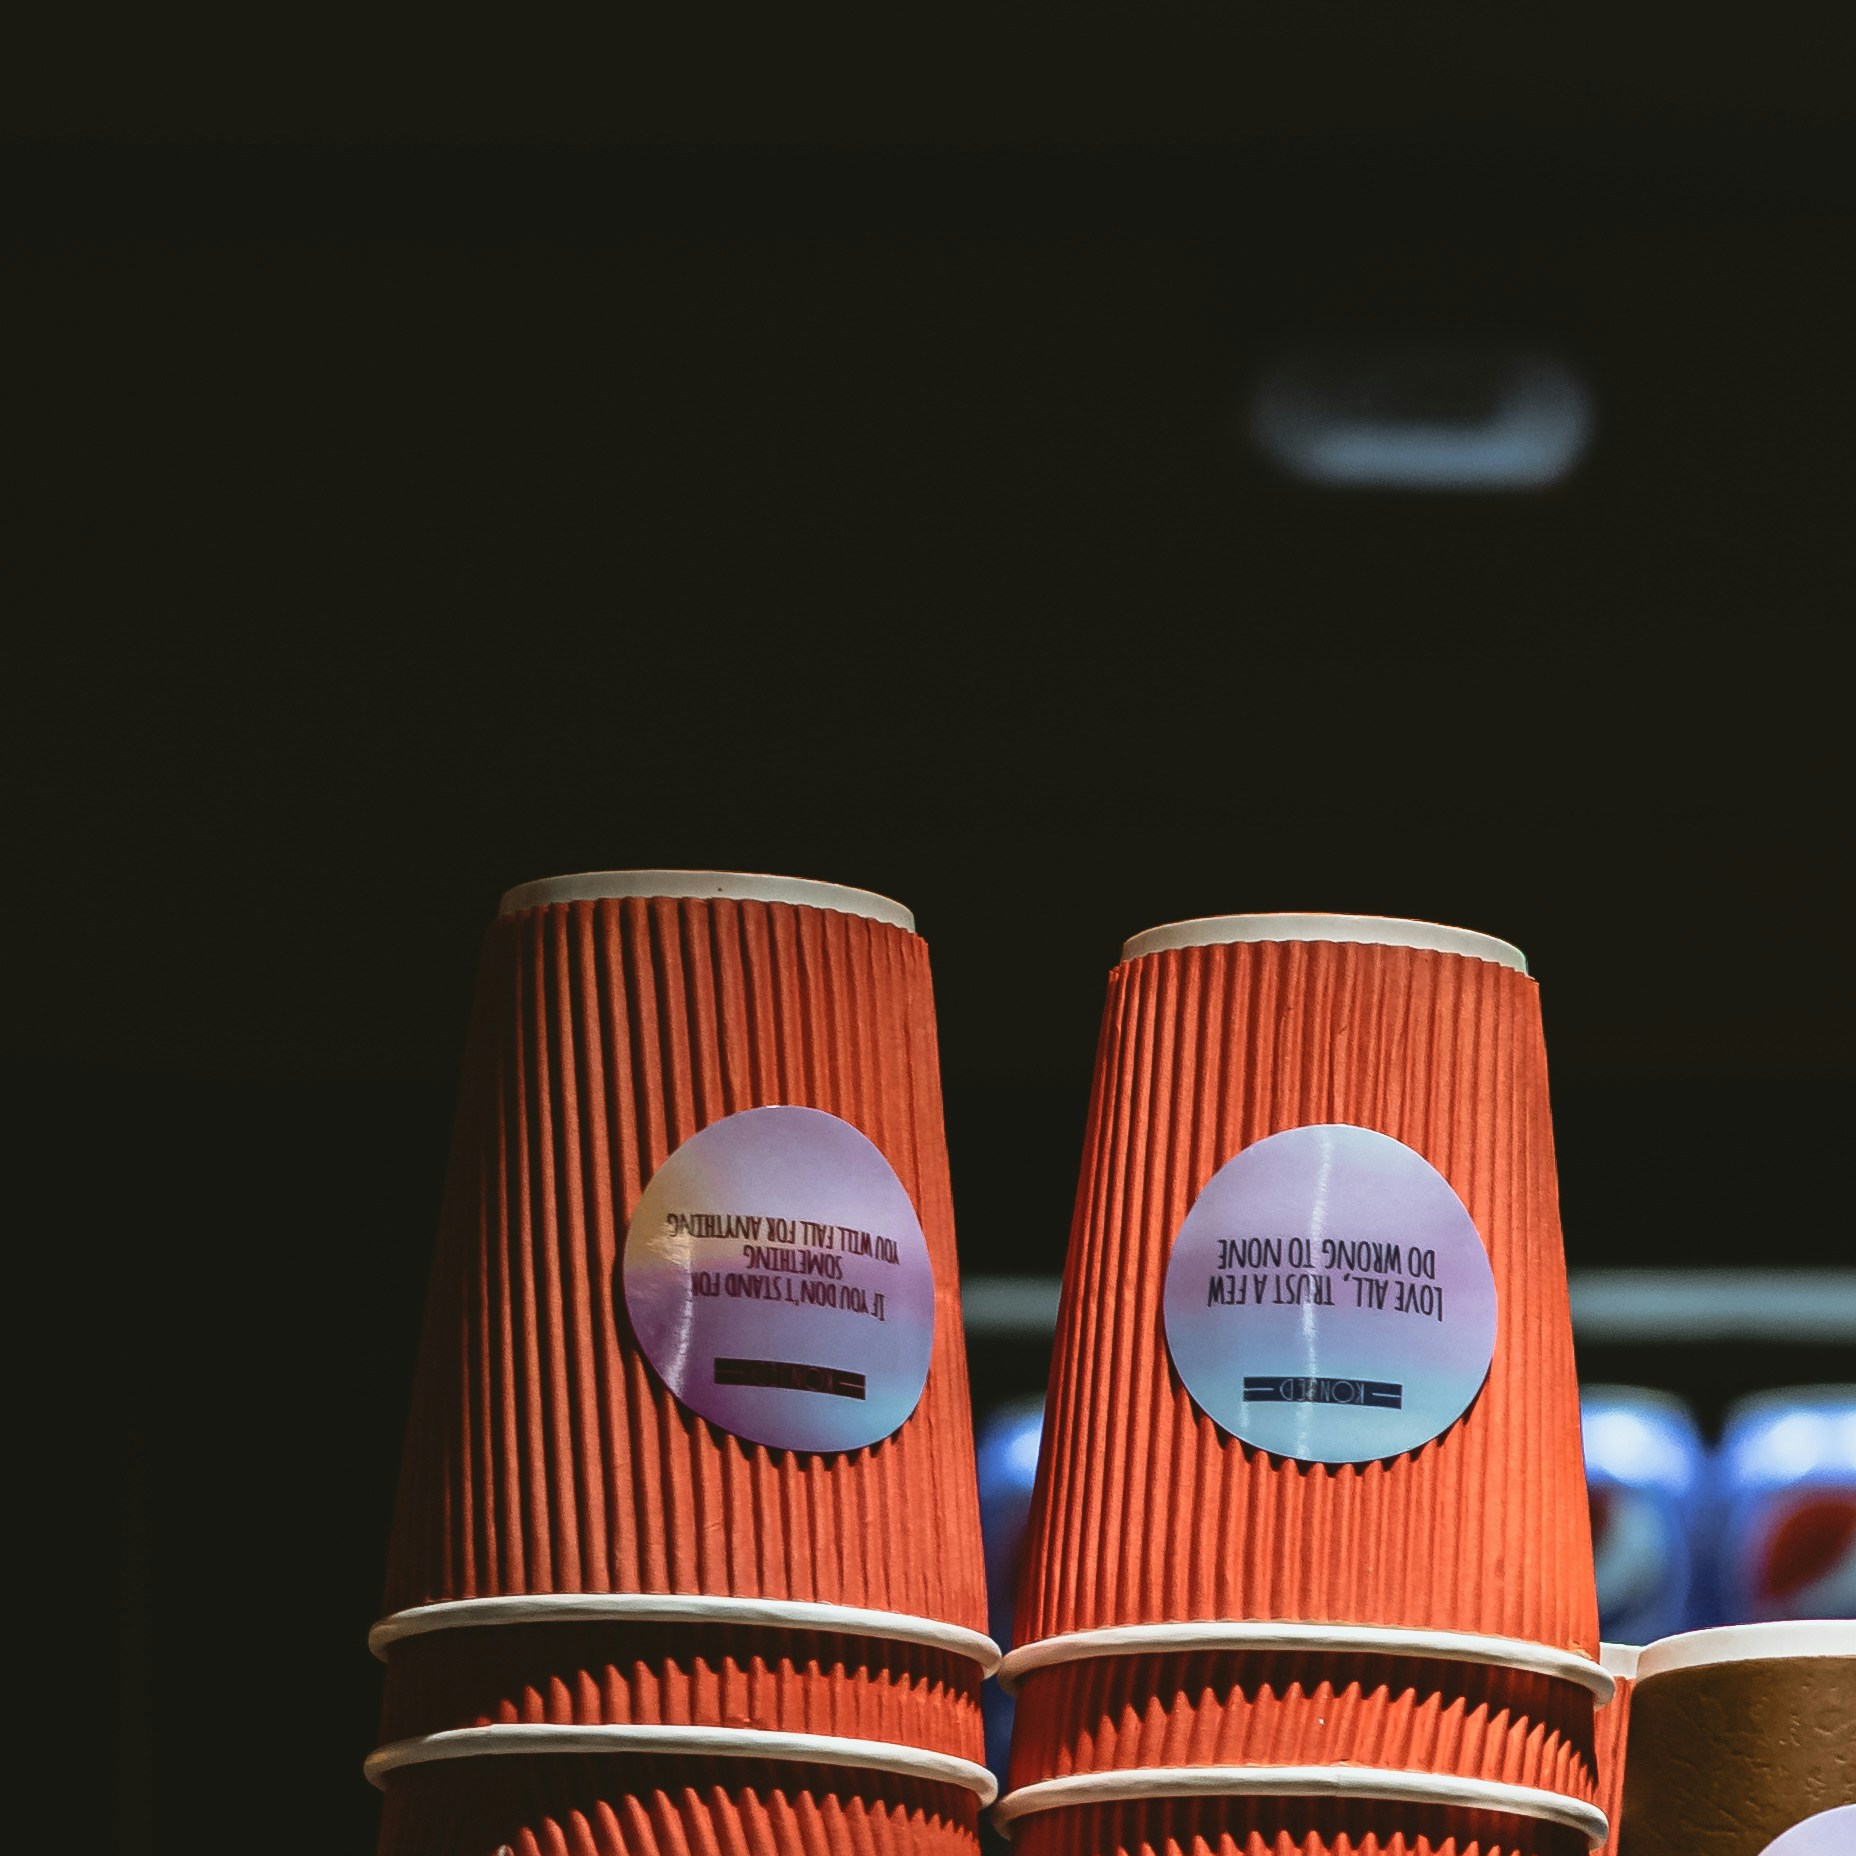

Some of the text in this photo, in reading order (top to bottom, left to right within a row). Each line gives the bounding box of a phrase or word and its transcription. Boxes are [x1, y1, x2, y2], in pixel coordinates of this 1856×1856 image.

[666, 1212, 900, 1265] YOU WILL FALL FOR ANYTHING
[743, 1244, 843, 1280] SOMETHING
[1216, 1236, 1436, 1280] DO WRONG TO NONE
[724, 1272, 784, 1301] STAND
[785, 1277, 837, 1307] DON'T
[841, 1284, 870, 1313] YOU
[1207, 1272, 1443, 1322] LOVE ALL, TRUST A FEW
[871, 1291, 886, 1321] IF
